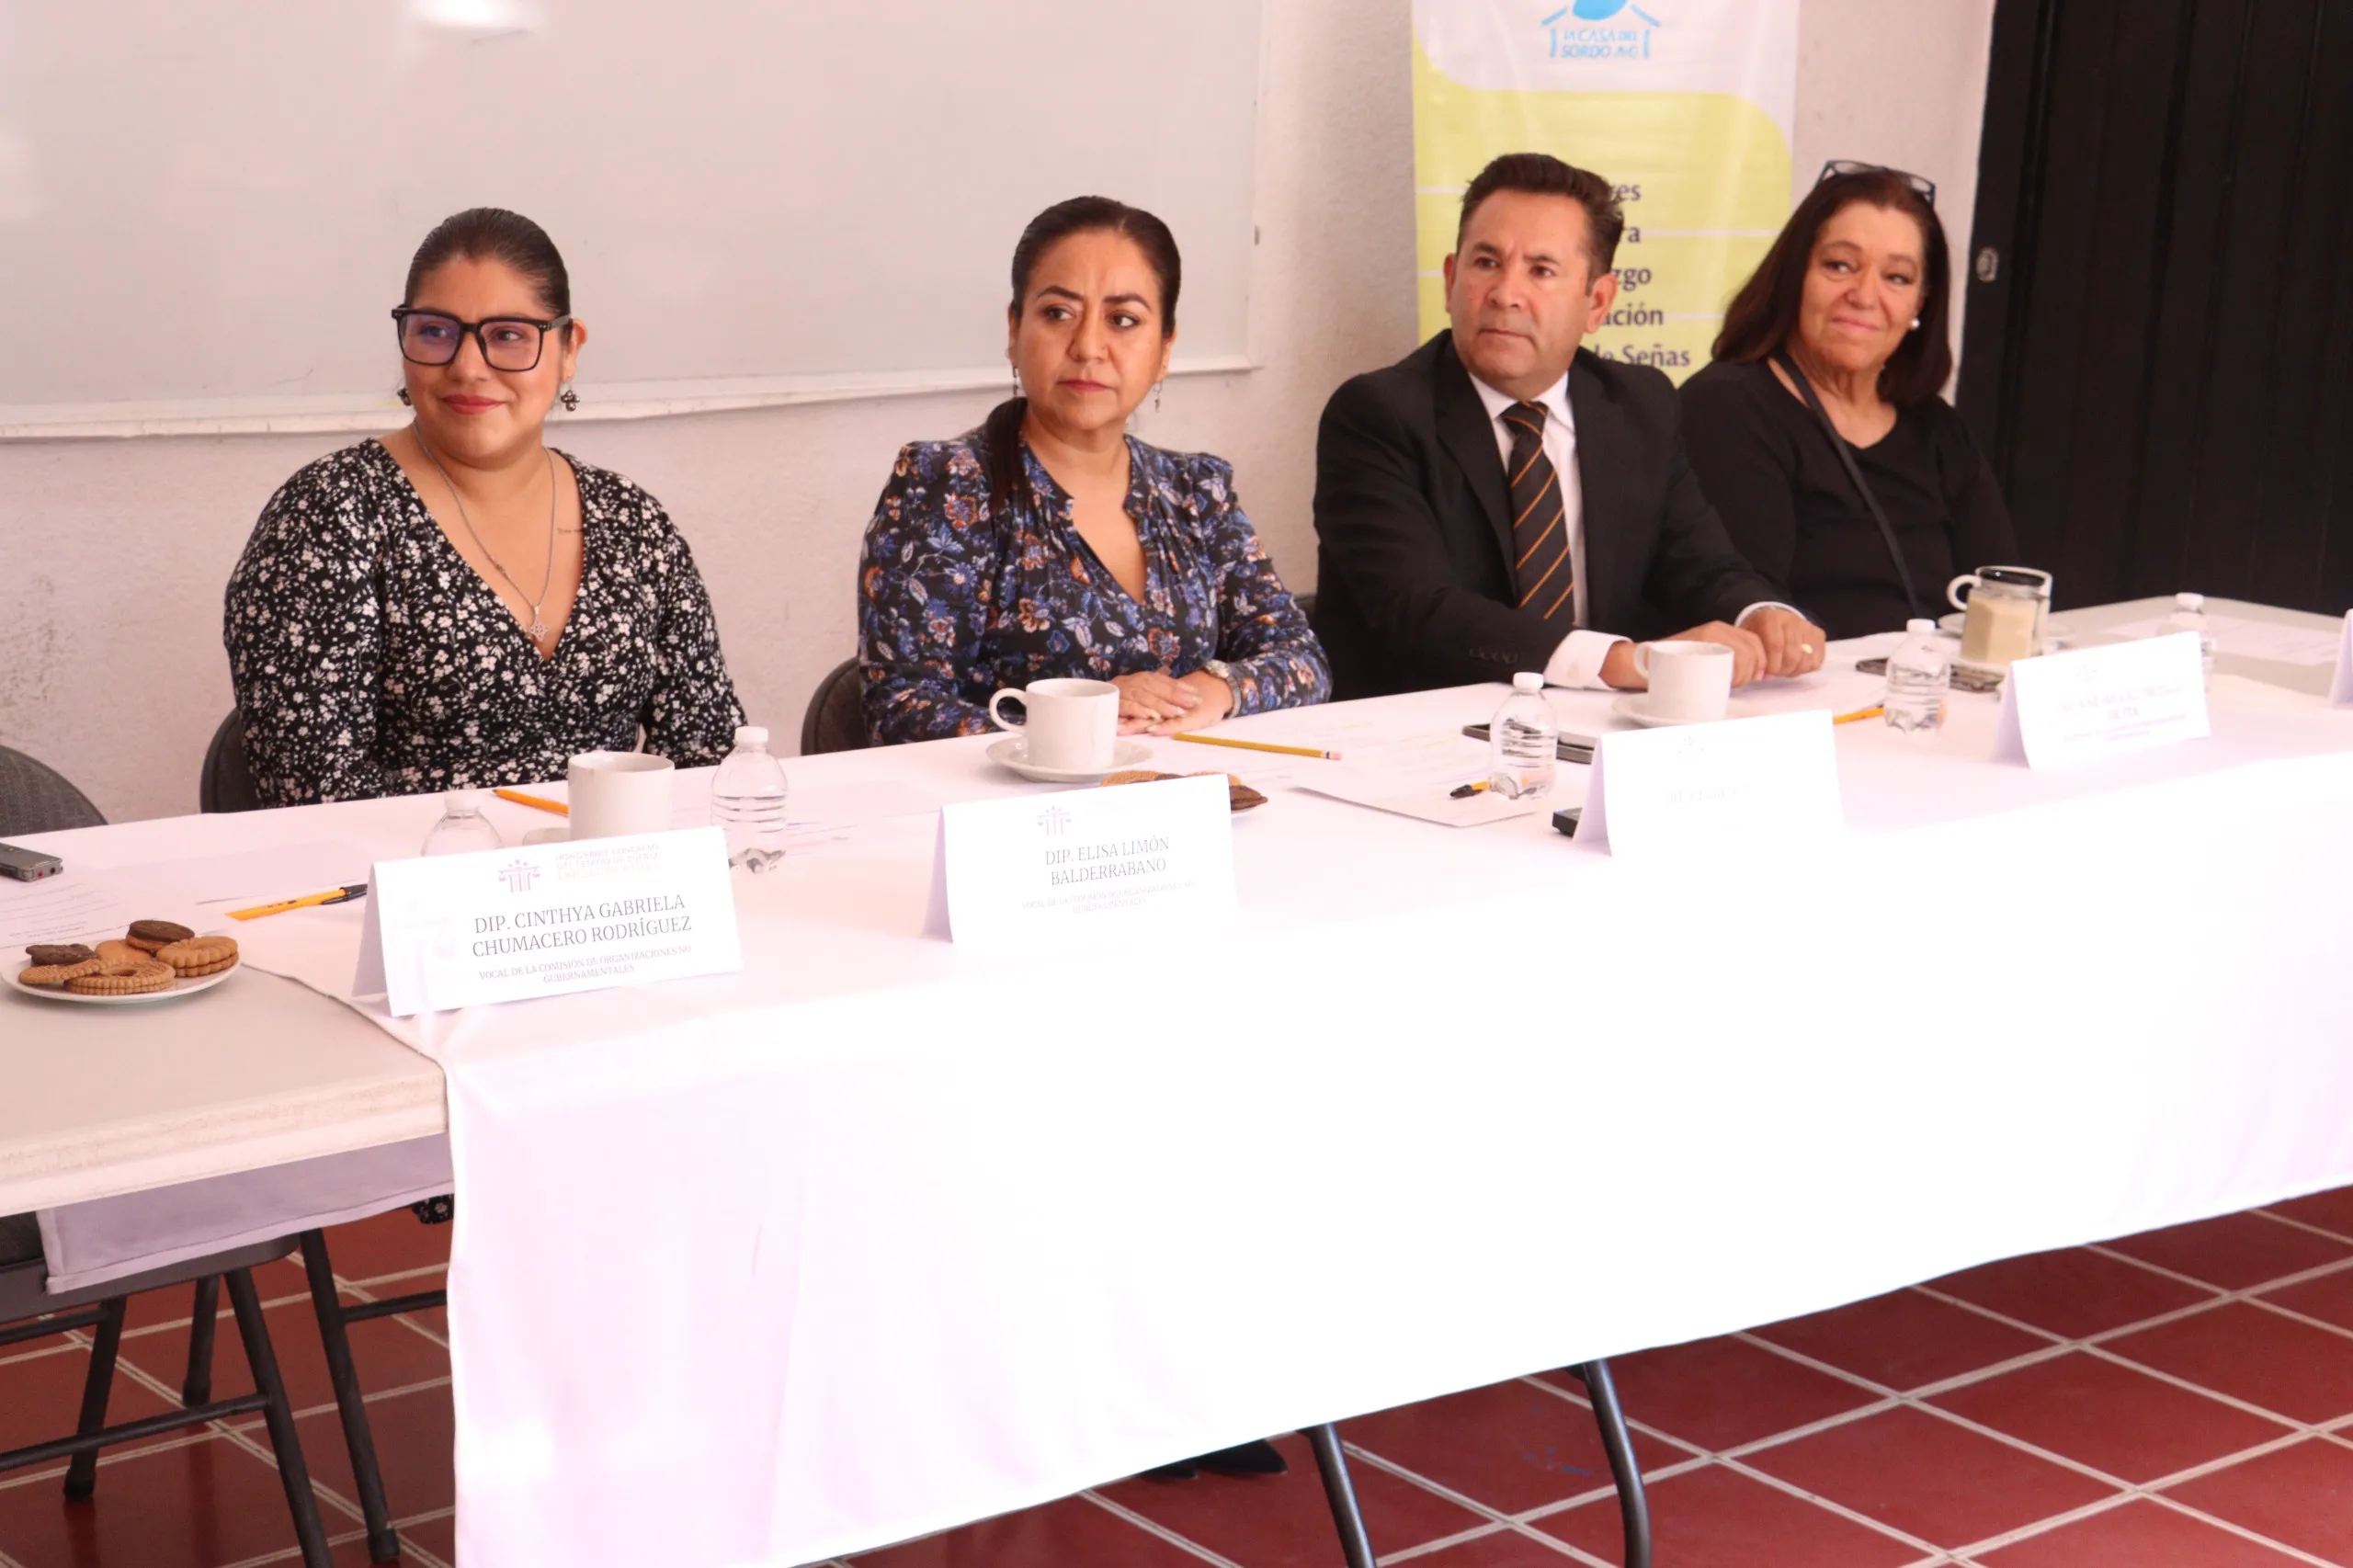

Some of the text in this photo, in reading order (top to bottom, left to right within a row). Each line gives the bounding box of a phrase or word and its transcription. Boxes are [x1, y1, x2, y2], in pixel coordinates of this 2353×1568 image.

[1578, 28, 1615, 41] CASA
[1562, 44, 1610, 58] SORDO
[1622, 343, 1690, 367] Señas
[1044, 835, 1170, 866] DIP. ELISA LIMÓN
[1051, 858, 1166, 886] BALDERRABANO
[474, 893, 687, 934] DIP. CINTHYA GABRIELA
[472, 915, 692, 958] CHUMACERO RODRÍGUEZ
[479, 945, 692, 981] VOCAL DE LA COMISIÓN DE ORGANIZACIONES NO
[543, 963, 635, 983] GUBERNAMENTALES
